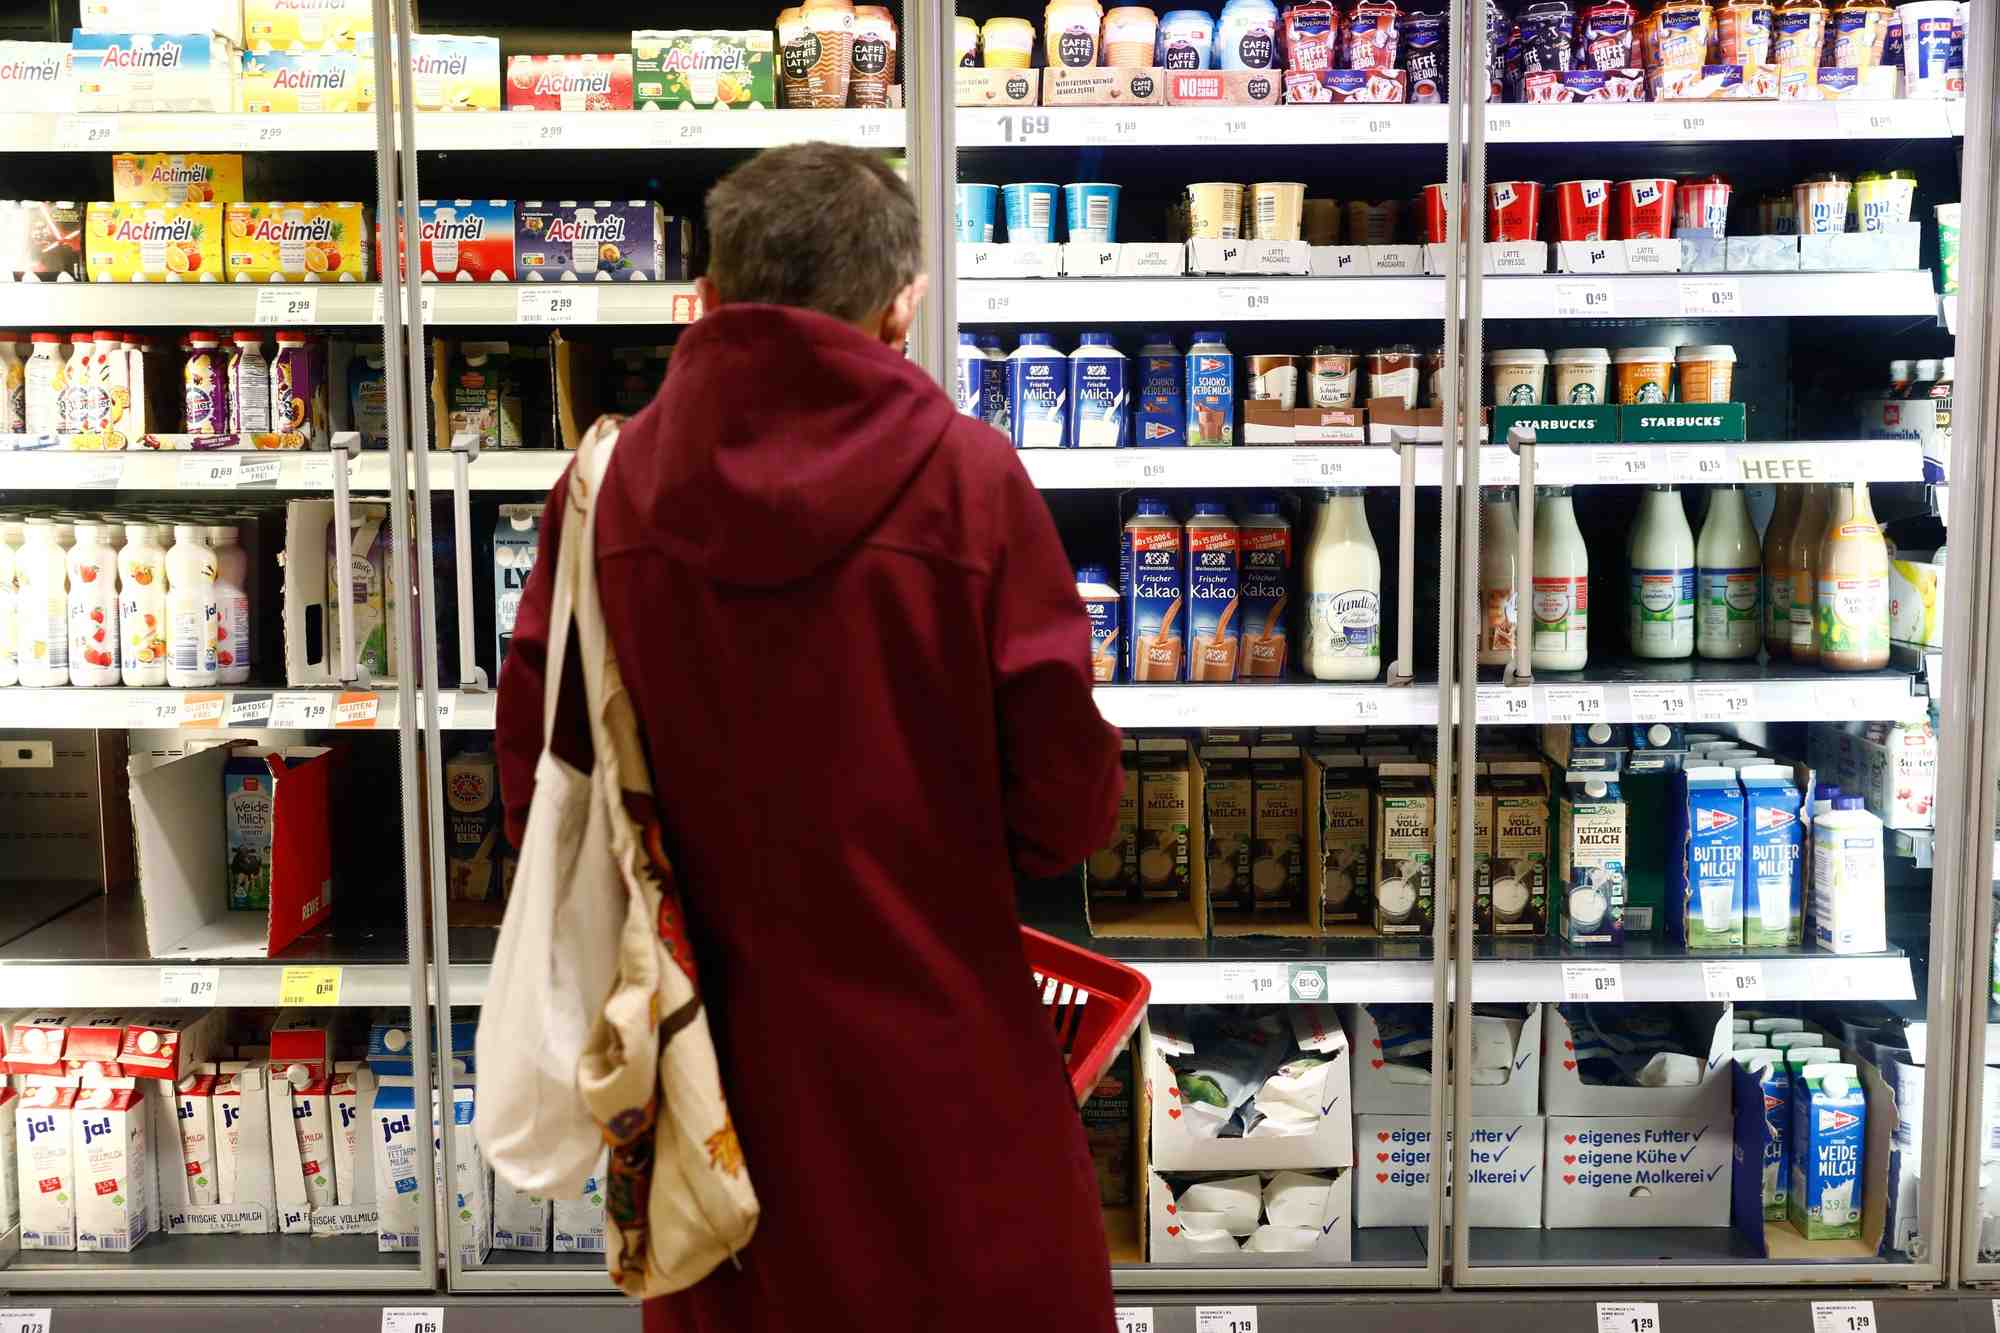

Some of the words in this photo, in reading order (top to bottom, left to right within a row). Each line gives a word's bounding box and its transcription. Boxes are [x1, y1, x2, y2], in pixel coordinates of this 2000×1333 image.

[103, 43, 182, 68] Actimel
[664, 48, 742, 72] Actimel
[855, 53, 884, 64] LATTE
[1063, 47, 1091, 57] LATTE
[1243, 49, 1270, 59] LATTE
[1593, 44, 1625, 62] CAFFÈ
[0, 57, 60, 81] ctimel
[411, 53, 467, 76] ctimel
[1168, 60, 1195, 70] LATTE
[274, 66, 346, 88] Actimel
[534, 73, 610, 96] Actimel
[1179, 78, 1198, 97] NO
[997, 115, 1050, 143] 1.69
[151, 165, 206, 183] Actimel
[1493, 190, 1511, 207] ja!
[1635, 187, 1655, 204] ja!
[116, 217, 191, 242] Actimel
[255, 217, 331, 242] Actimel
[546, 216, 624, 241] Actimel
[1223, 247, 1237, 261] ja!
[1383, 253, 1399, 261] LATTE
[1502, 250, 1520, 258] LATTE
[1590, 250, 1606, 264] ja!
[1636, 247, 1654, 255] LATTE
[1337, 254, 1352, 268] ja!
[1497, 258, 1526, 266] ESPRESSO
[287, 300, 310, 314] 2.99
[550, 298, 572, 312] 2.99
[1198, 377, 1226, 387] SCHOKO
[1023, 388, 1057, 401] Milch
[1080, 388, 1114, 401] Milch
[1514, 419, 1596, 430] STARBUCKS
[1640, 416, 1721, 428] STARBUCKS
[1741, 459, 1815, 480] HEFE
[1143, 574, 1172, 583] Frischer
[1199, 575, 1228, 584] Frischer
[1135, 583, 1180, 599] Kakao
[1190, 584, 1236, 600] Kakao
[1241, 583, 1286, 599] Kakao
[1091, 626, 1112, 638] kao
[234, 800, 270, 813] Weide
[1147, 799, 1185, 809] MILCH
[237, 813, 267, 825] Milch
[1209, 808, 1247, 817] MILCH
[1261, 808, 1298, 817] MILCH
[1397, 819, 1422, 827] VOLL-
[1390, 827, 1429, 837] MILCH
[1502, 826, 1541, 837] MILCH
[1578, 834, 1620, 845] MILCH
[1694, 846, 1741, 862] BUTTER
[1752, 844, 1800, 860] BUTTER
[1699, 861, 1736, 878] MILCH
[1758, 859, 1794, 876] MILCH
[177, 1101, 195, 1120] a!
[293, 1100, 313, 1120] a!
[26, 1115, 56, 1143] ja!
[82, 1117, 112, 1144] ja!
[381, 1113, 411, 1143] ja!
[1578, 1129, 1641, 1147] eigenes
[1644, 1129, 1690, 1143] Futter
[1577, 1150, 1633, 1168] eigene
[1635, 1149, 1678, 1164] Kühe
[1818, 1145, 1858, 1161] WEIDE
[1819, 1160, 1857, 1177] MILCH
[1577, 1170, 1632, 1188] eigene
[1635, 1168, 1704, 1184] Molkerei
[169, 1213, 185, 1228] ja!
[187, 1213, 218, 1225] FRISCHE
[221, 1211, 263, 1224] VOLLMILCH
[285, 1212, 301, 1227] ja!
[1631, 1318, 1653, 1333] 1.29
[1847, 1316, 1869, 1331] 1.29
